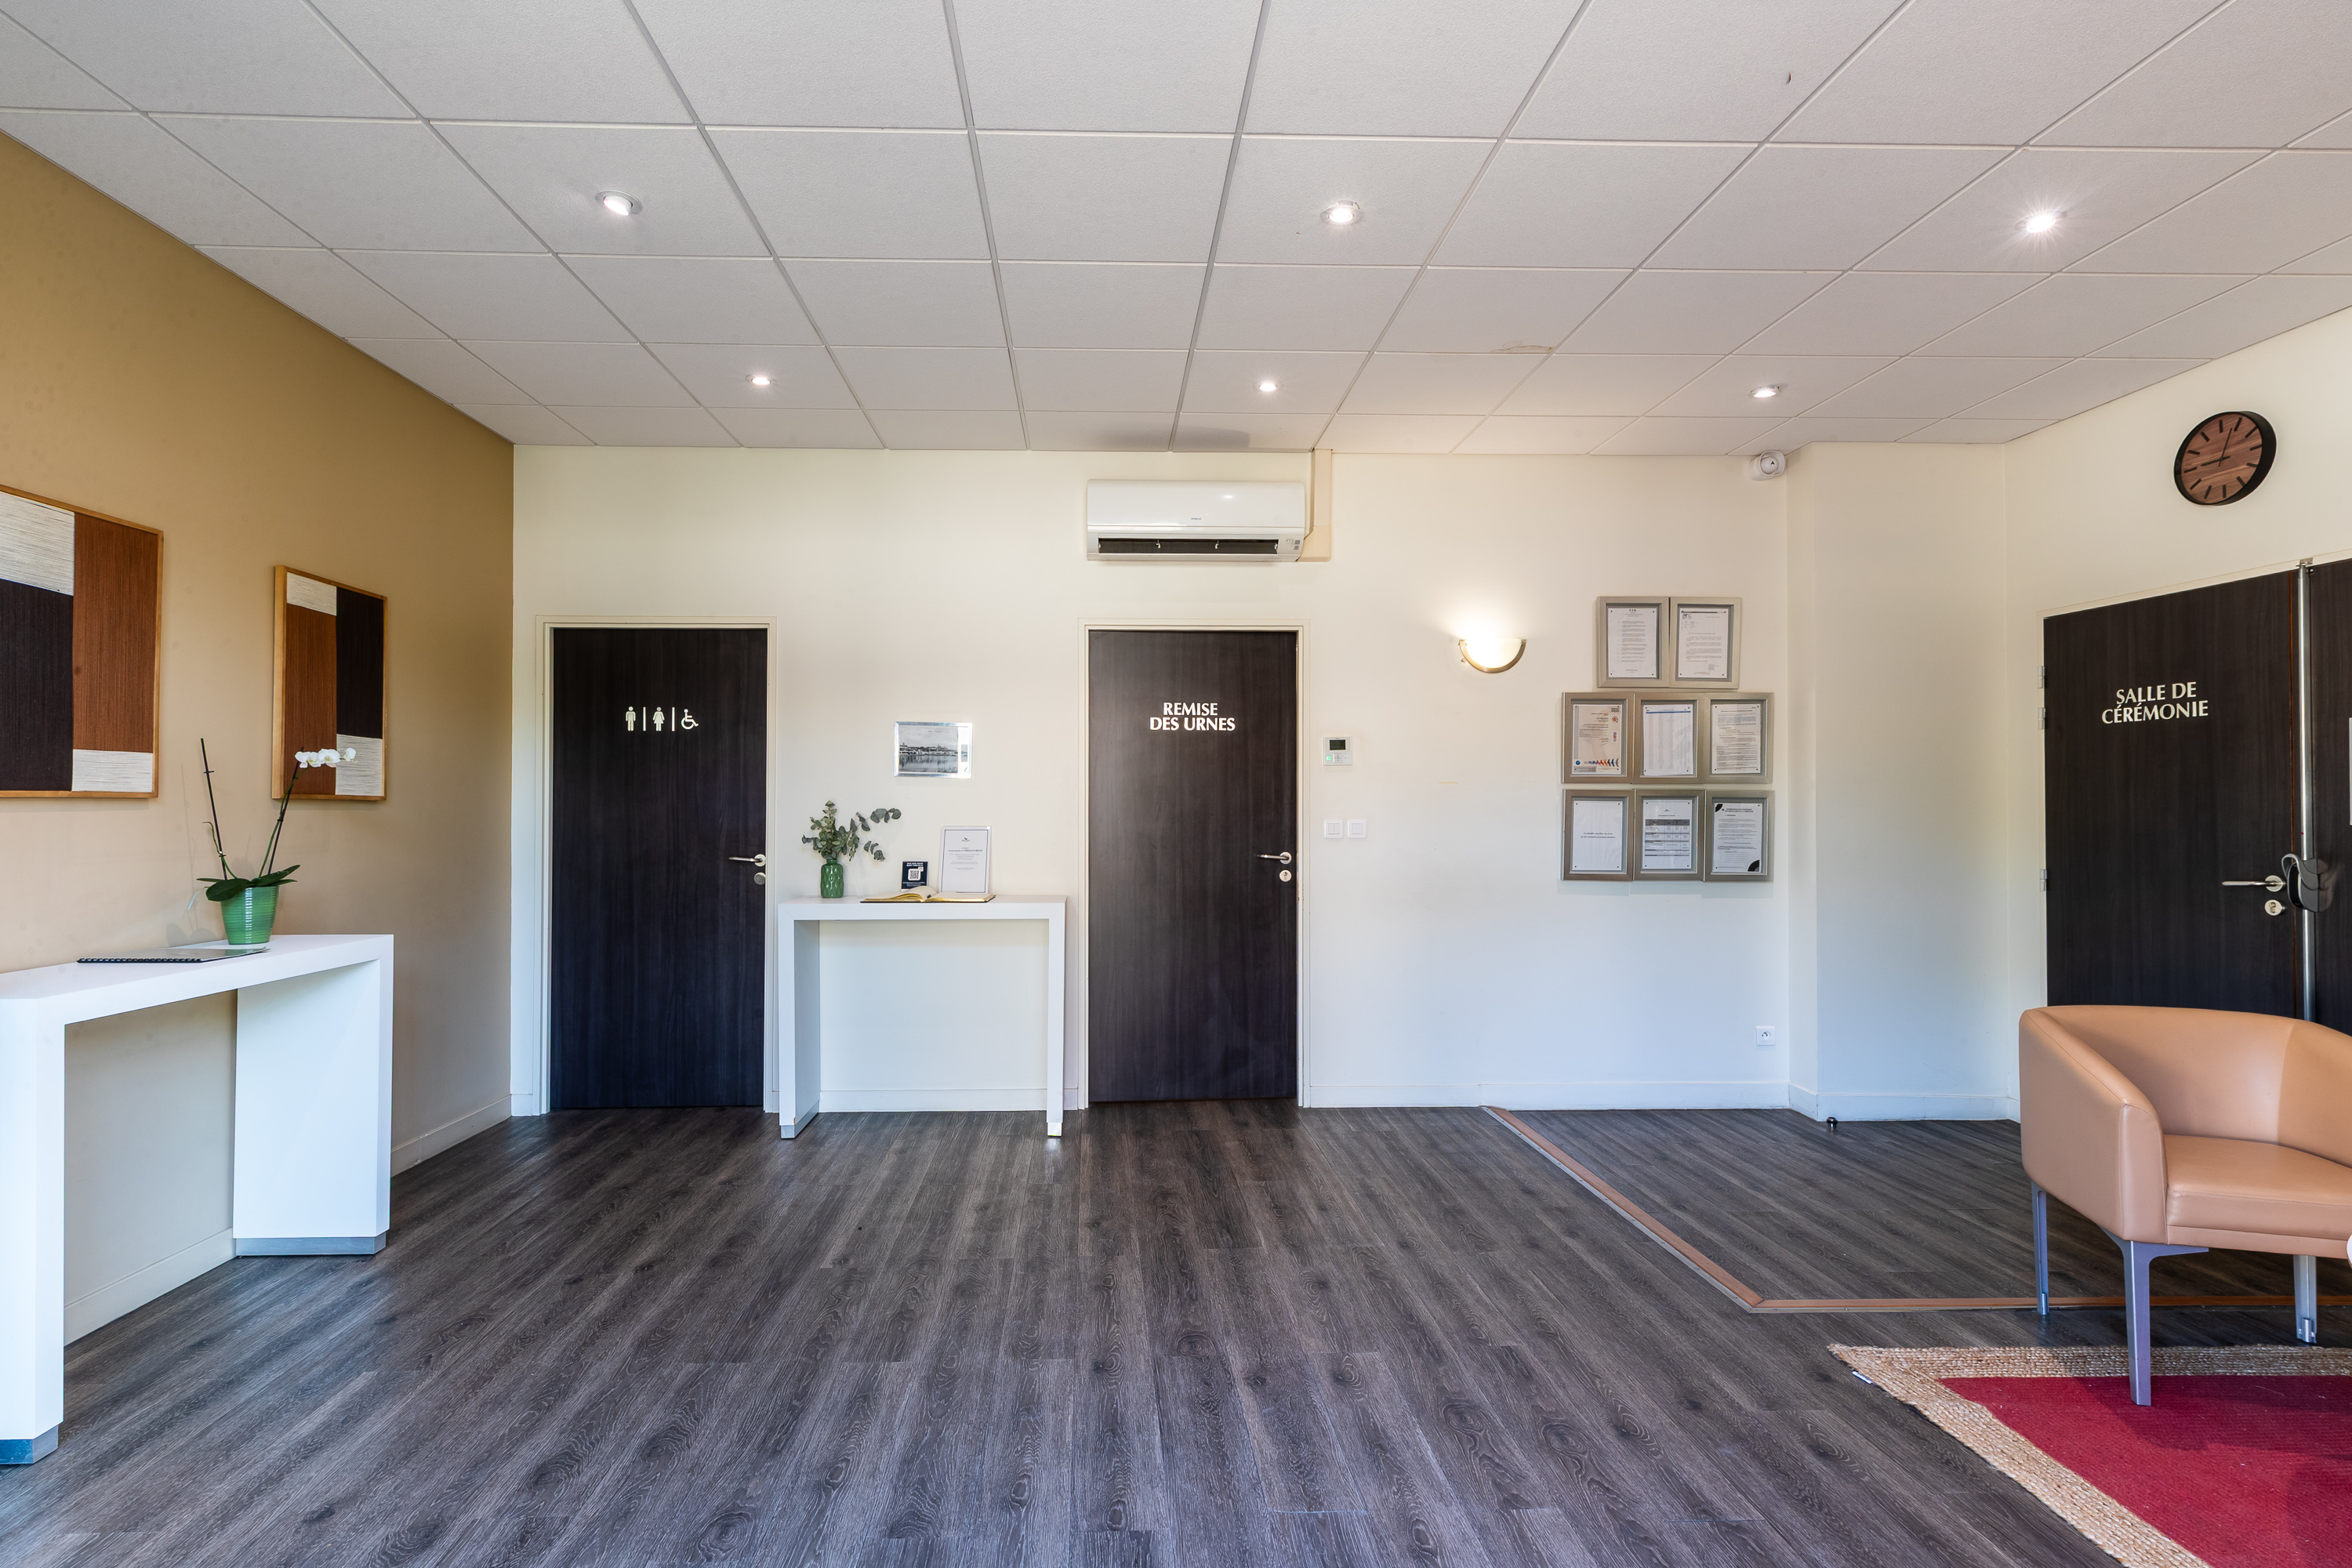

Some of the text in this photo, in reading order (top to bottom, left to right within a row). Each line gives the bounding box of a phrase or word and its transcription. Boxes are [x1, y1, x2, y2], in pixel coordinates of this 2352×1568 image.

[2117, 681, 2197, 704] SALLE DE
[1163, 702, 1218, 716] REMISE
[2102, 700, 2209, 724] CÉRÉMONIE
[1150, 717, 1236, 731] DES URNES
